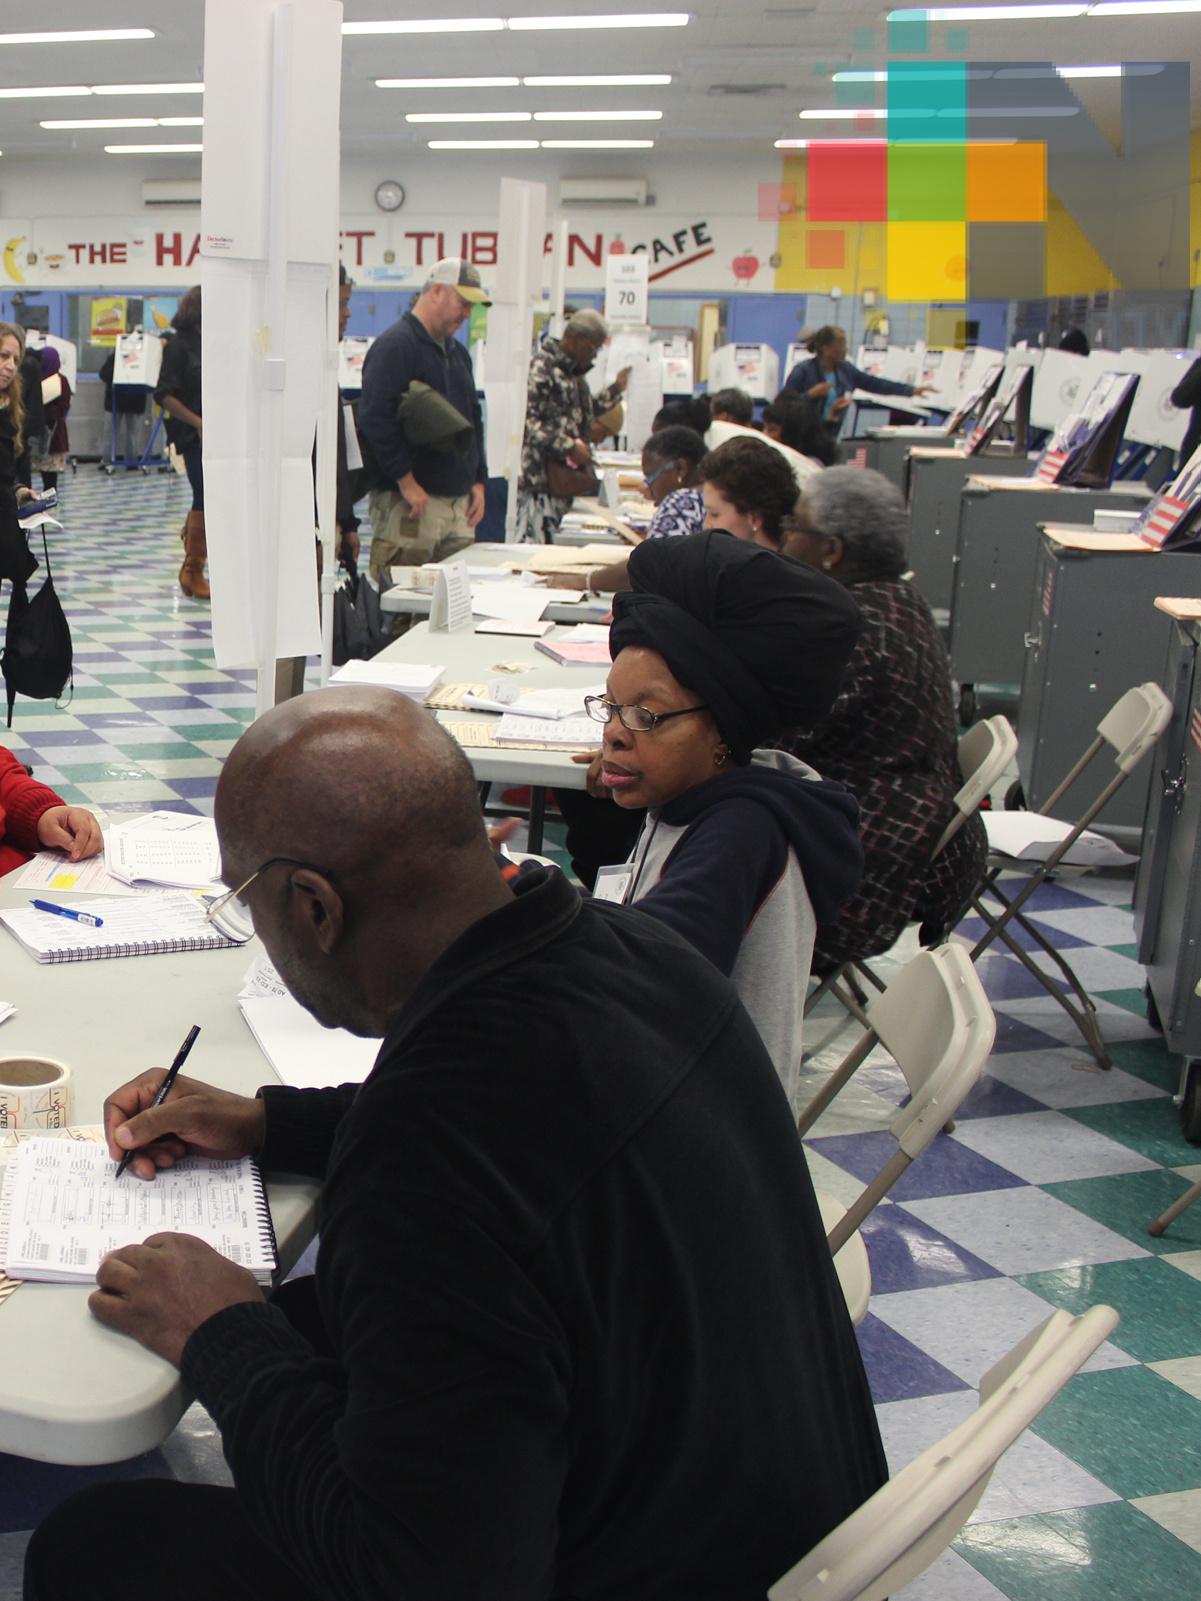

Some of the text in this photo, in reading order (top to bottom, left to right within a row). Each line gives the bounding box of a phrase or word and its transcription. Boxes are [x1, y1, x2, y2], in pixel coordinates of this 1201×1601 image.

[68, 242, 128, 264] THE
[618, 291, 636, 306] 70
[0, 1103, 8, 1129] VOTE
[53, 1099, 61, 1128] VOTED
